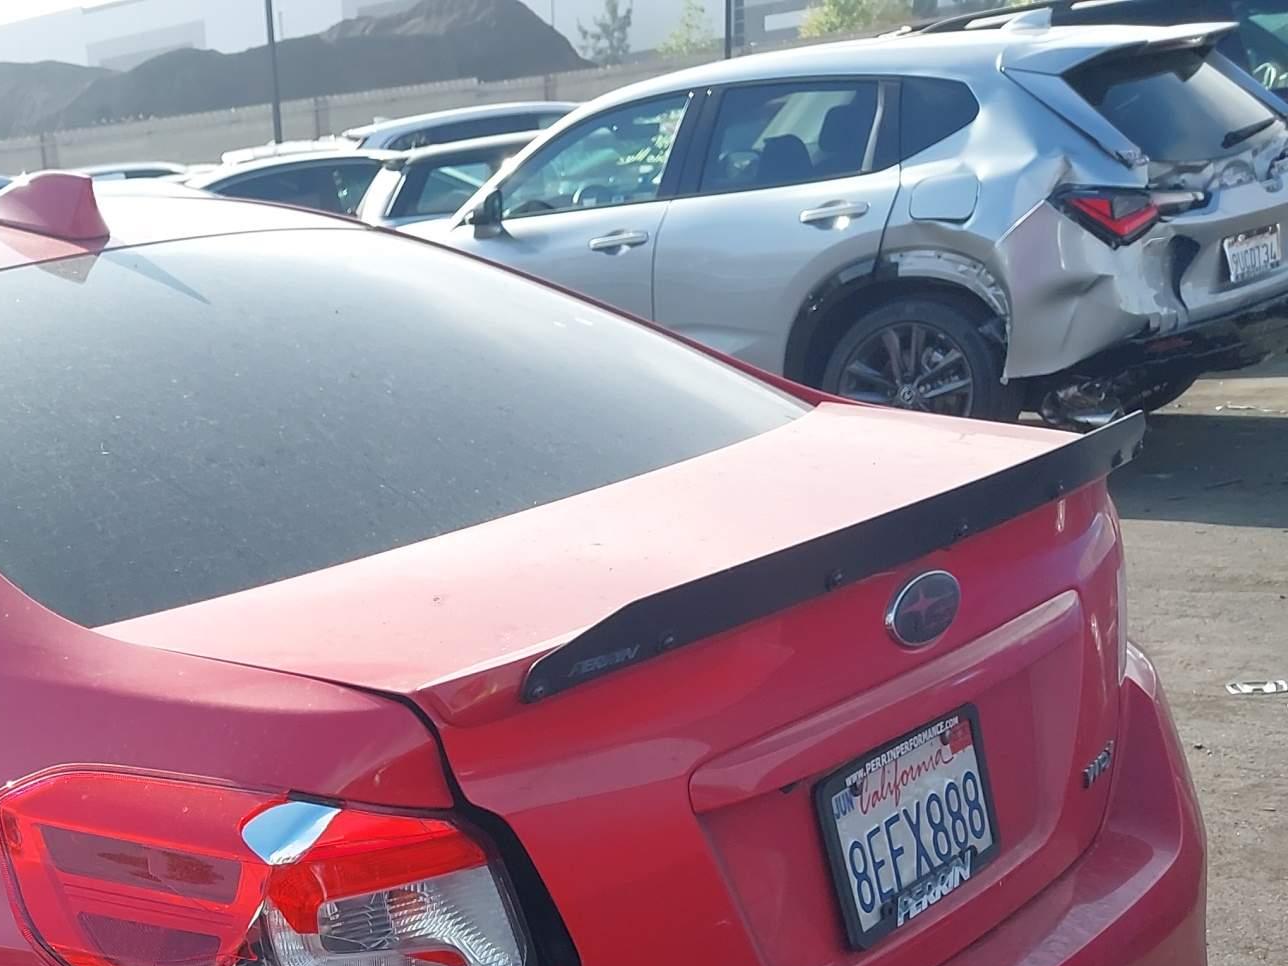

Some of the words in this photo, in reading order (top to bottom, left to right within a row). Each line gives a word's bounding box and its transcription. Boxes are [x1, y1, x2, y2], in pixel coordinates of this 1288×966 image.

[858, 748, 954, 816] California
[848, 770, 986, 914] 8EFX888
[896, 850, 974, 927] PERRIN
